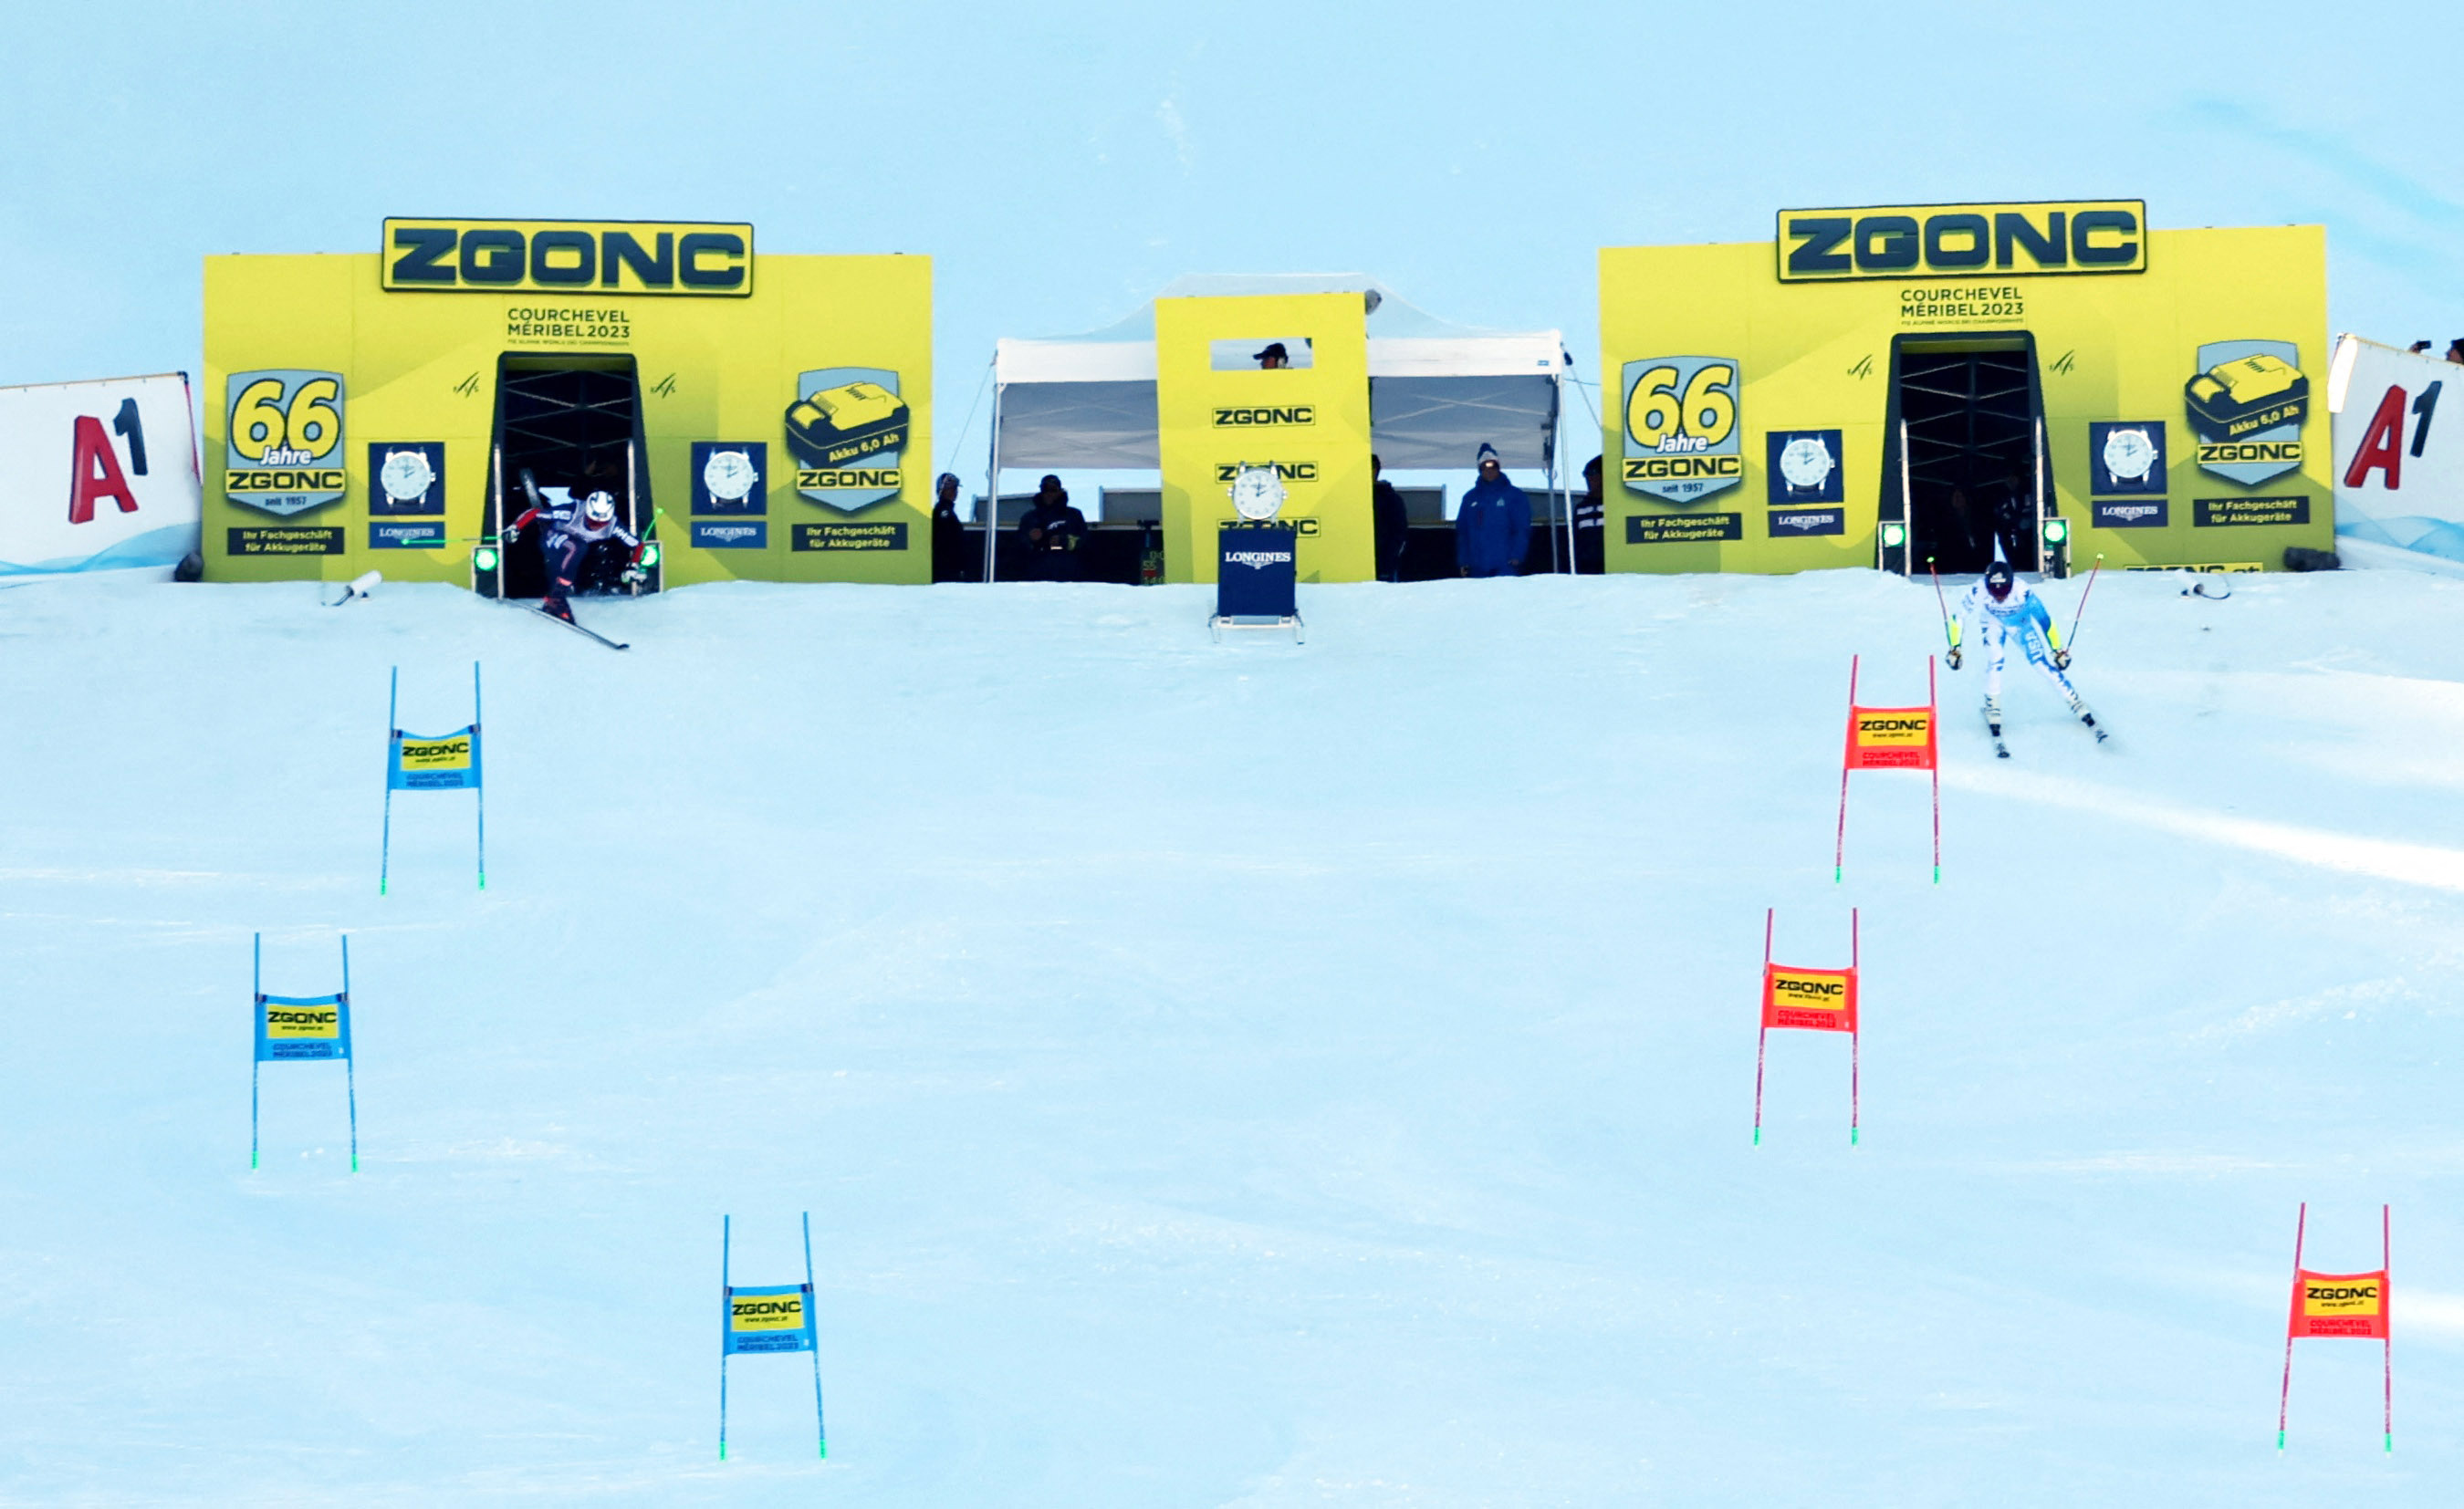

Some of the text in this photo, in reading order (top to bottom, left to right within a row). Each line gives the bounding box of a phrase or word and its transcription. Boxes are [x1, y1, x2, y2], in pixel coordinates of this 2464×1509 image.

[1788, 210, 2138, 274] ZGONC
[392, 227, 746, 289] ZGONC
[1901, 286, 2023, 302] COURCHEVEL
[507, 307, 630, 322] COURCHEVEL
[1626, 364, 1737, 448] 66
[230, 378, 340, 461] 66
[1216, 407, 1312, 425] ZGONC
[2229, 420, 2259, 436] Akku
[2344, 380, 2443, 491] A1
[829, 446, 860, 463] Akku
[883, 433, 900, 446] Ah
[1656, 432, 1707, 453] Jahre
[68, 397, 148, 525] A1
[259, 445, 312, 465] Jahre
[2199, 443, 2301, 462] ZGONC
[1218, 463, 1315, 482] ZNC
[1625, 457, 1739, 479] ZGONC
[228, 471, 343, 490] ZGONC
[799, 470, 900, 487] ZGONC
[1682, 483, 1704, 493] 1957
[2102, 505, 2158, 516] LONGINES
[1225, 551, 1290, 562] LONGINES
[1859, 719, 1927, 731] ZGONC
[402, 742, 469, 756] ZGONC
[1775, 979, 1843, 995] ZGONC
[267, 1011, 337, 1024] ZGONC
[2306, 1286, 2377, 1299] ZGONC
[732, 1300, 801, 1316] ZGONC
